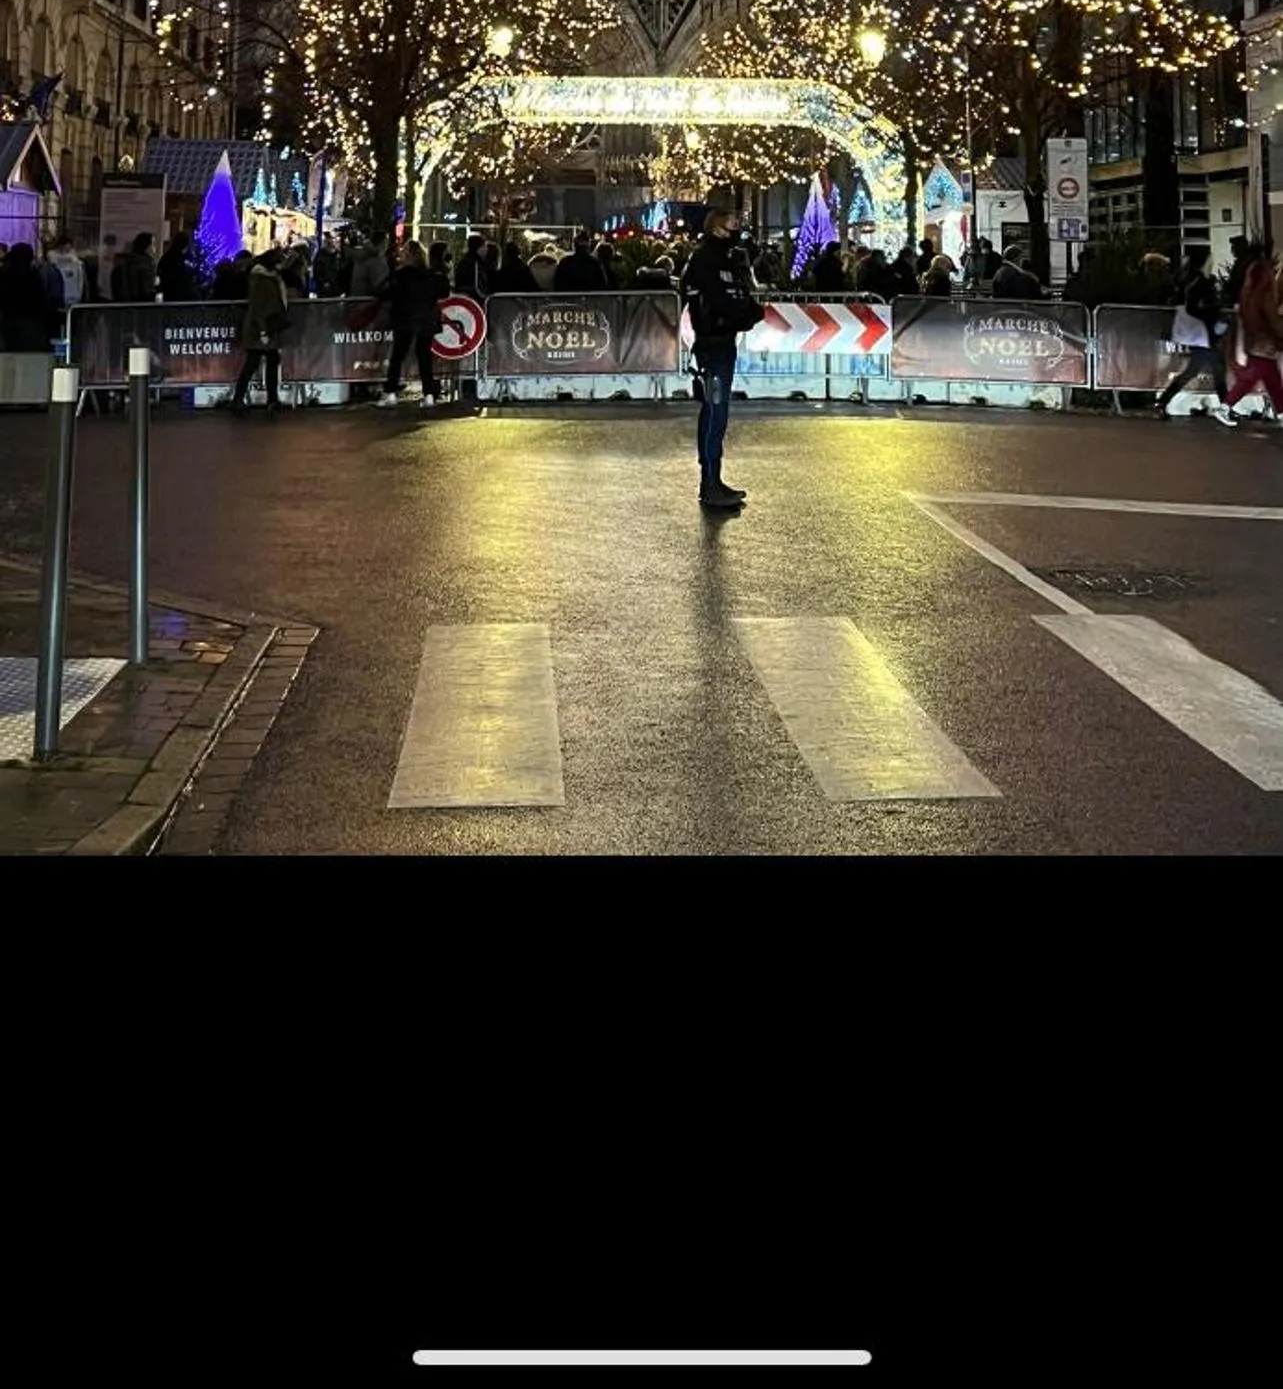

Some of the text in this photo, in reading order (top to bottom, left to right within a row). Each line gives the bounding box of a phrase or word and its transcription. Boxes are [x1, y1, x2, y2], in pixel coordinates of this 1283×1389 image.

[164, 327, 236, 339] BIENVENUE
[334, 330, 394, 343] WILLKOM
[169, 343, 231, 354] WELCOME
